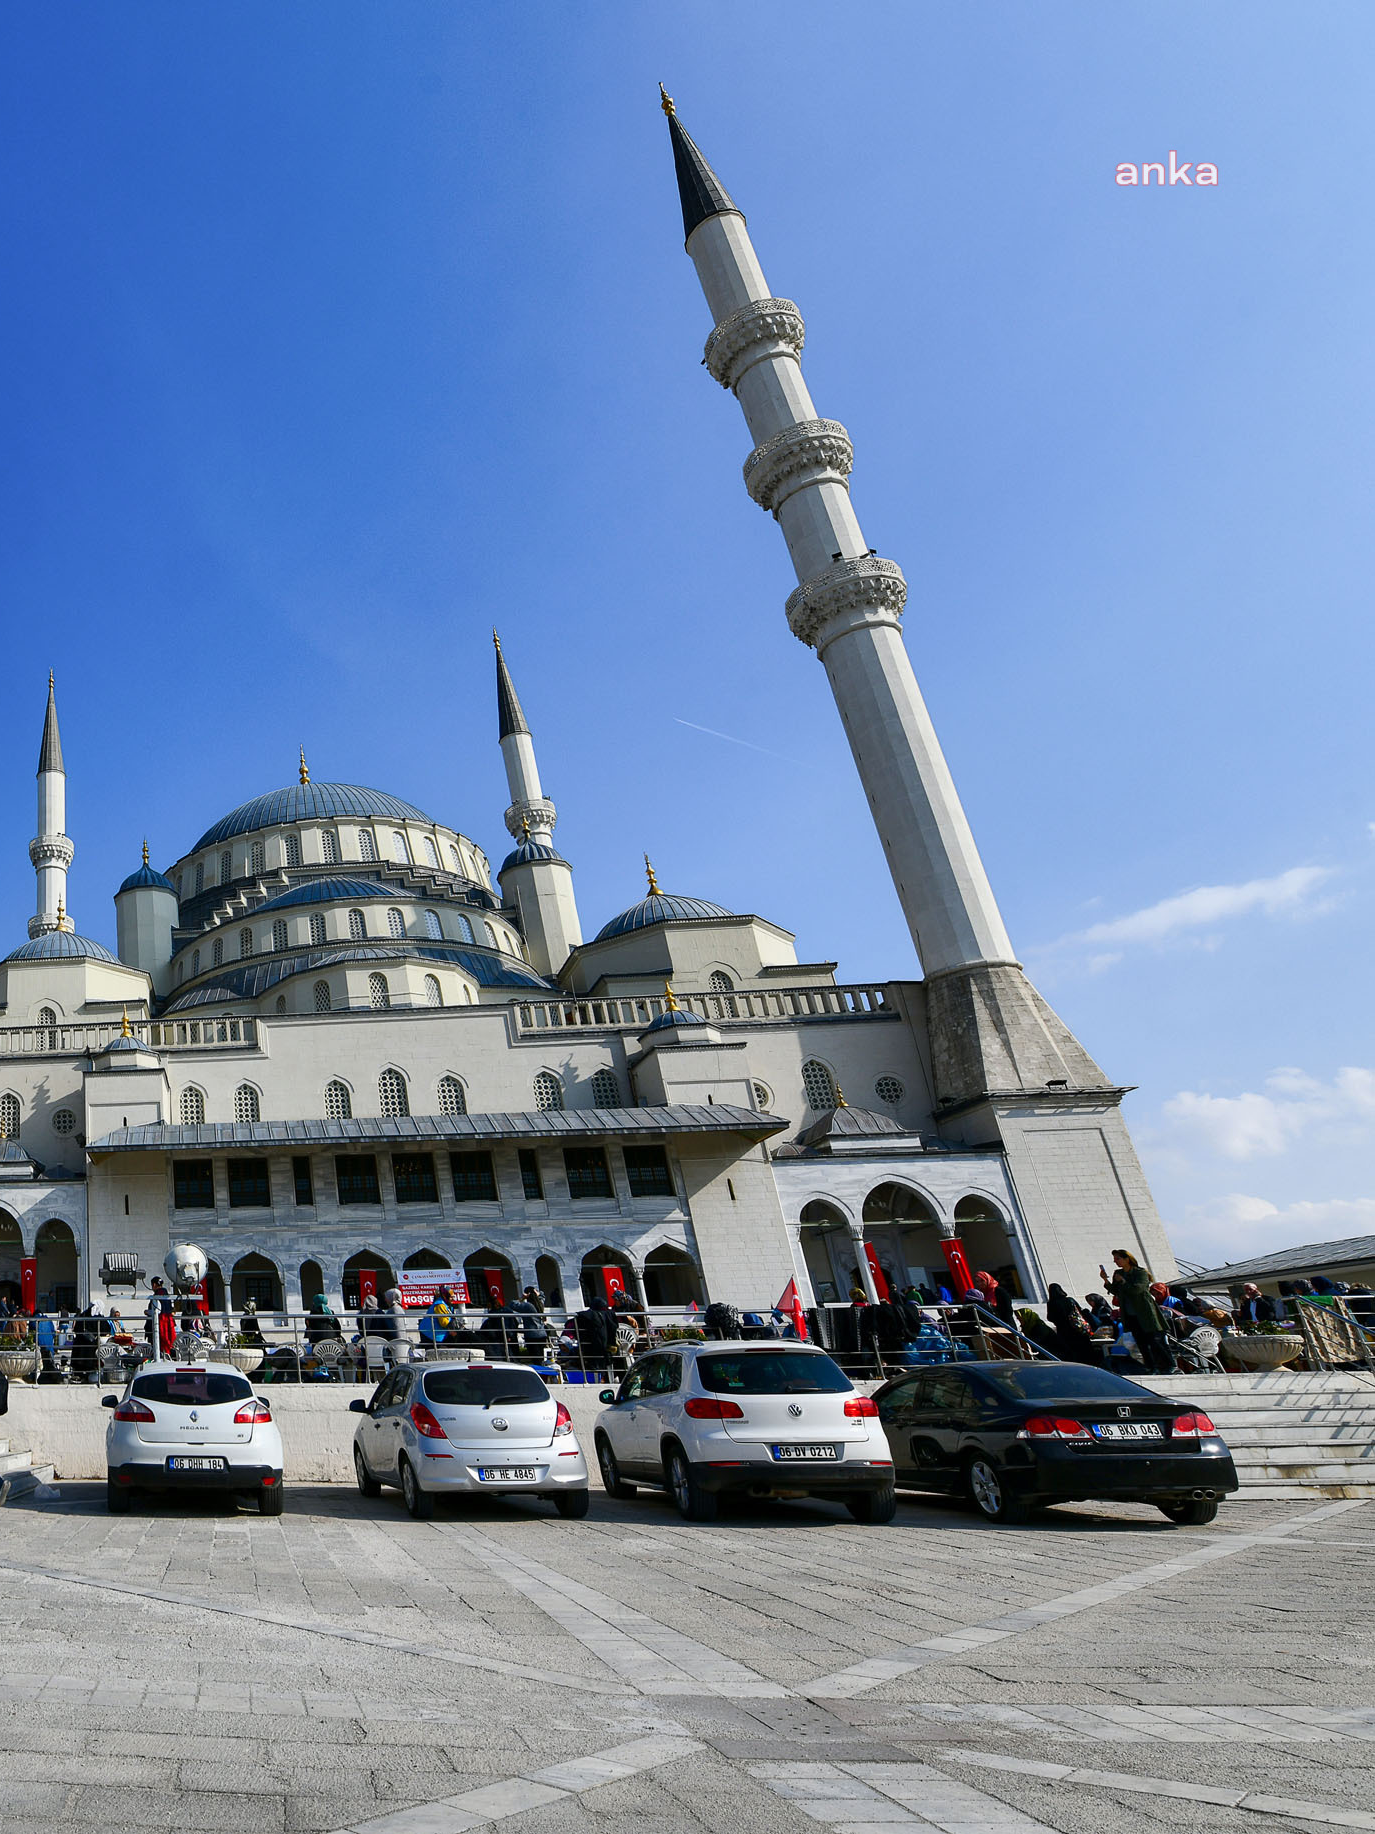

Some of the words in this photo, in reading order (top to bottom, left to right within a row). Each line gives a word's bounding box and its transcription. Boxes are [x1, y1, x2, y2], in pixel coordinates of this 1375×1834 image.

[1099, 1425, 1113, 1436] 06
[1118, 1425, 1137, 1436] BKD
[1140, 1425, 1160, 1435] 043
[779, 1446, 792, 1457] 06
[795, 1446, 806, 1457] DV
[810, 1446, 834, 1457] 0212
[174, 1459, 185, 1470] 06
[188, 1459, 204, 1470] DHH
[208, 1459, 222, 1469] 184
[485, 1469, 495, 1479] 06
[500, 1469, 510, 1479] HE
[514, 1468, 534, 1479] 4845
